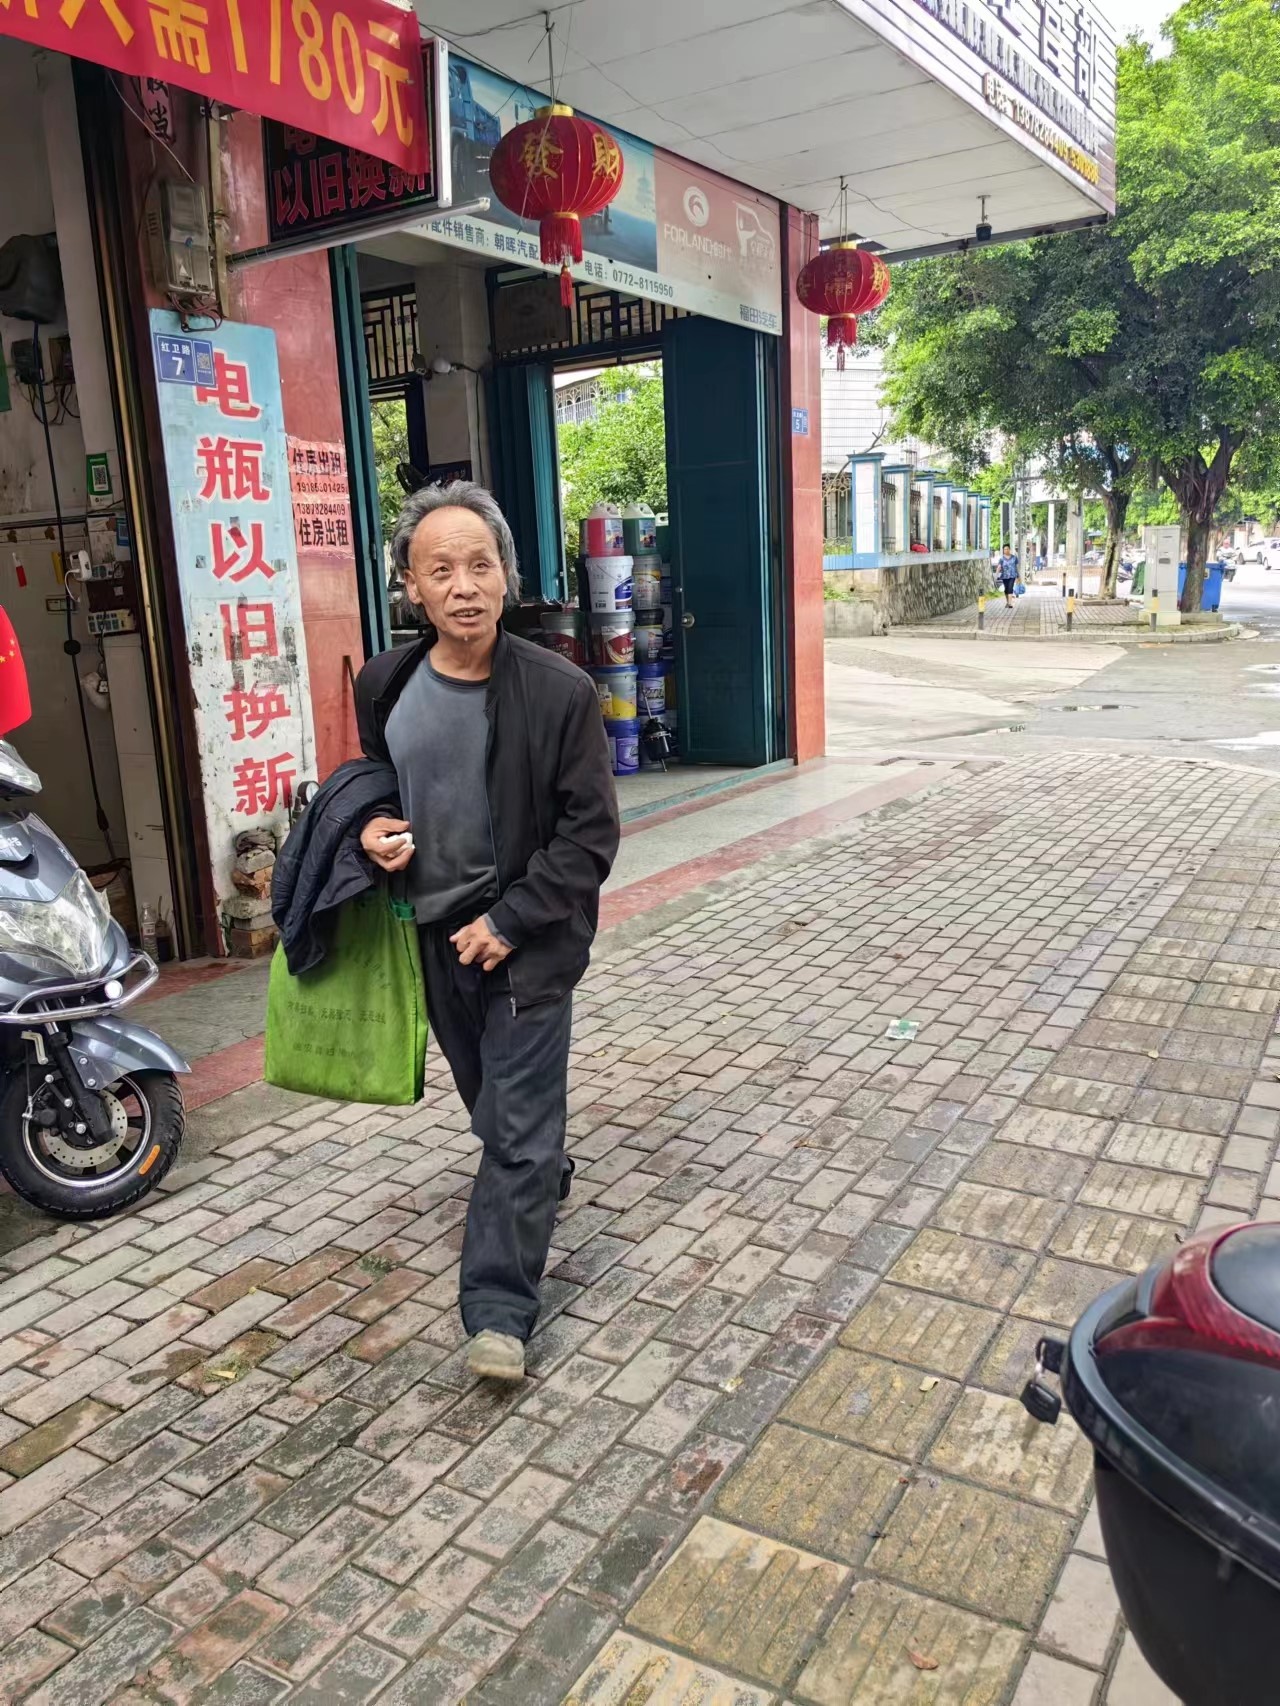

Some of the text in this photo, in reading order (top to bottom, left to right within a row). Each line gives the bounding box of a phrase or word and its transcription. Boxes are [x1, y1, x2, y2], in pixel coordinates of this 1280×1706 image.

[0, 0, 414, 147] 需1780元
[739, 303, 778, 330] 福田汽车
[161, 341, 191, 356] 红卫路
[171, 356, 183, 376] 7
[299, 518, 349, 546] 住房出租
[195, 350, 297, 818] 电瓶以旧换新
